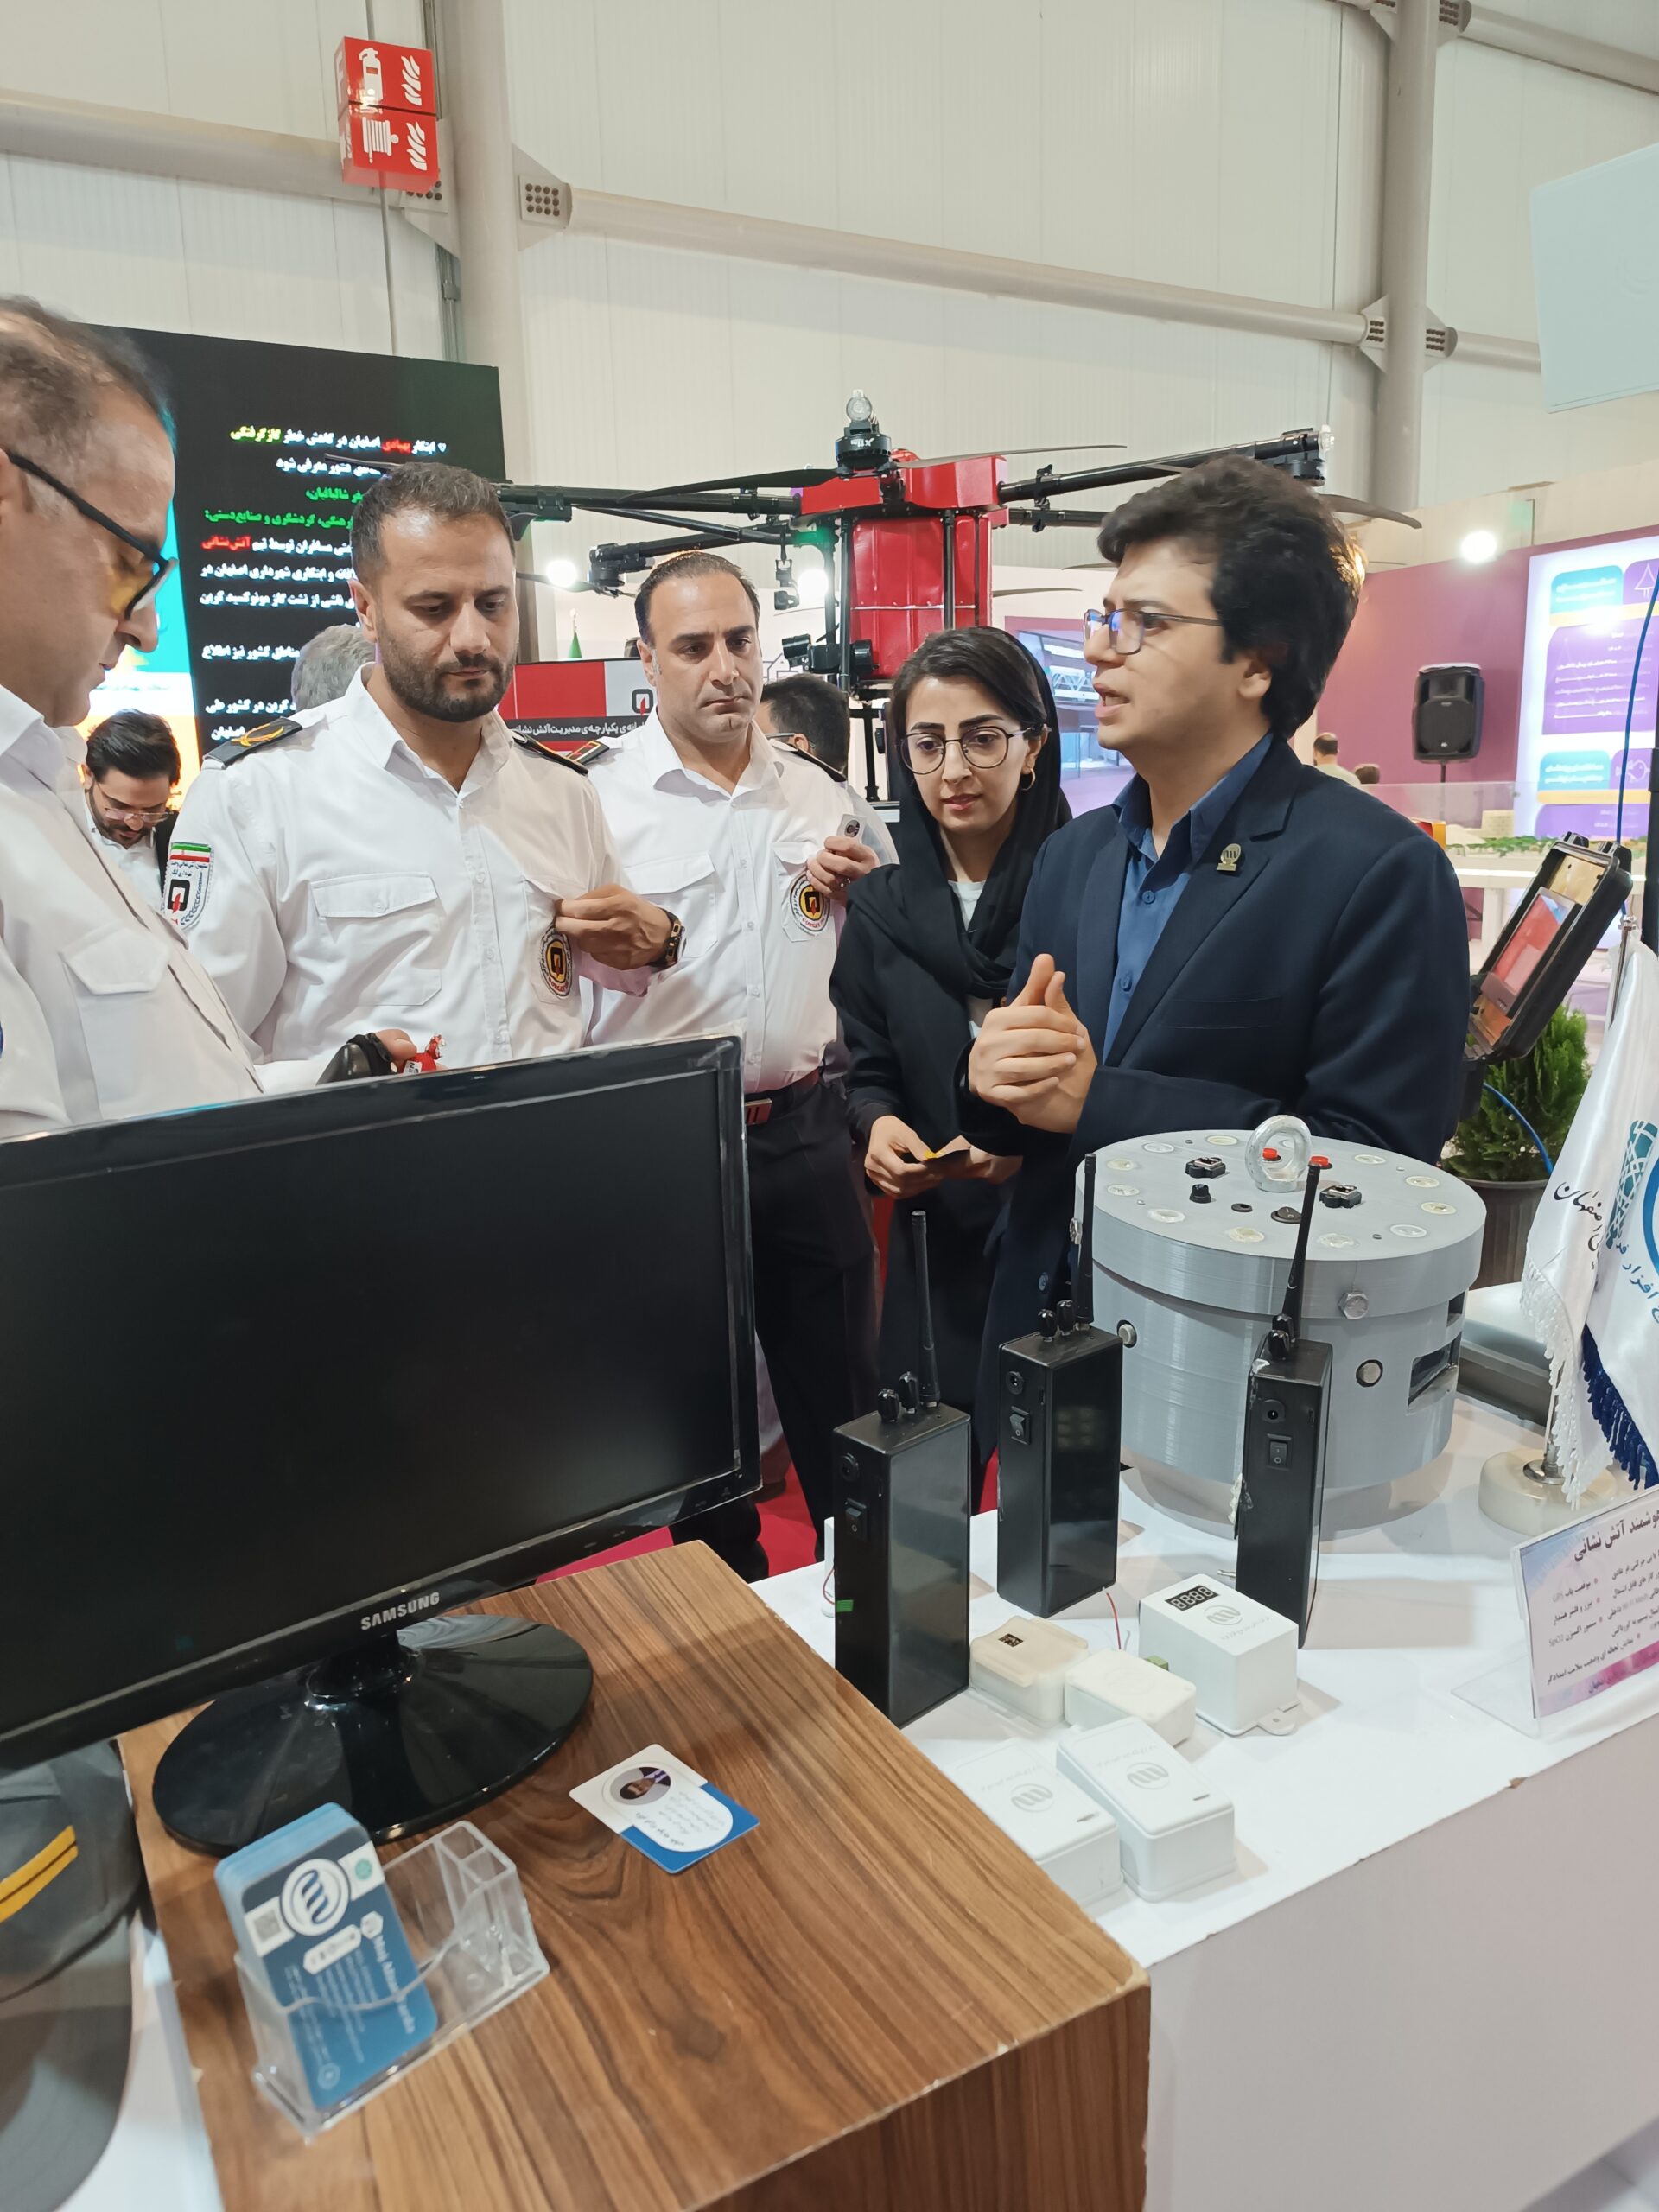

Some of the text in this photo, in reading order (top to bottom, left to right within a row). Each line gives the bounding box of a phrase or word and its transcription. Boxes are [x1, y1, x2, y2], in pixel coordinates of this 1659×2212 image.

[283, 429, 305, 444] خطر
[306, 432, 335, 447] کاهش
[335, 435, 348, 448] در
[348, 435, 381, 449] اصفهان
[276, 457, 296, 472] شود
[264, 515, 270, 524] و
[251, 537, 268, 551] تیم
[268, 537, 296, 553] توسط
[296, 539, 334, 555] مسافران
[200, 563, 214, 578] در
[213, 563, 249, 578] اصفهان
[249, 564, 291, 581] شهرداری
[291, 566, 327, 582] ابتکاری
[327, 570, 334, 582] و
[199, 590, 225, 606] کربن
[271, 592, 287, 607] گاز
[310, 594, 320, 608] از
[201, 644, 232, 660] اطلاع
[232, 645, 245, 660] نیز
[246, 645, 270, 660] کشور
[226, 698, 251, 714] کشور
[251, 701, 265, 714] در
[265, 698, 289, 714] کربن
[211, 726, 245, 741] اصفهان
[1605, 1518, 1625, 1548] آتش
[1573, 1531, 1602, 1562] نشانی
[360, 1592, 440, 1630] SAMSUNG
